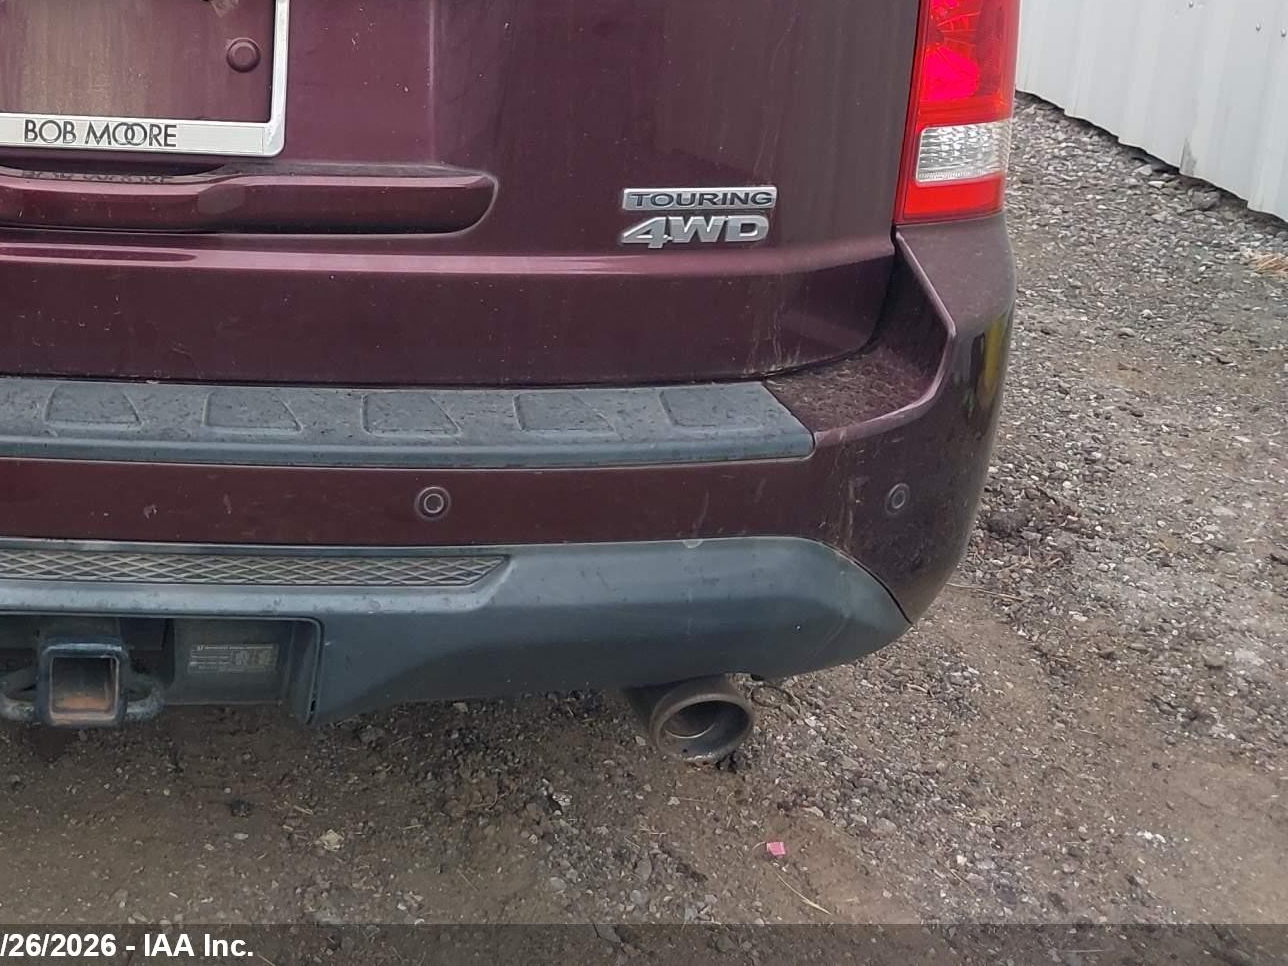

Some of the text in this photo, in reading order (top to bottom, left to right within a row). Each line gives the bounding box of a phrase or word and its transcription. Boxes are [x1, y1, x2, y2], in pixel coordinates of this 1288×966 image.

[24, 119, 177, 147] BOB MOORE
[631, 191, 773, 207] TOURING
[621, 215, 770, 249] 4WD
